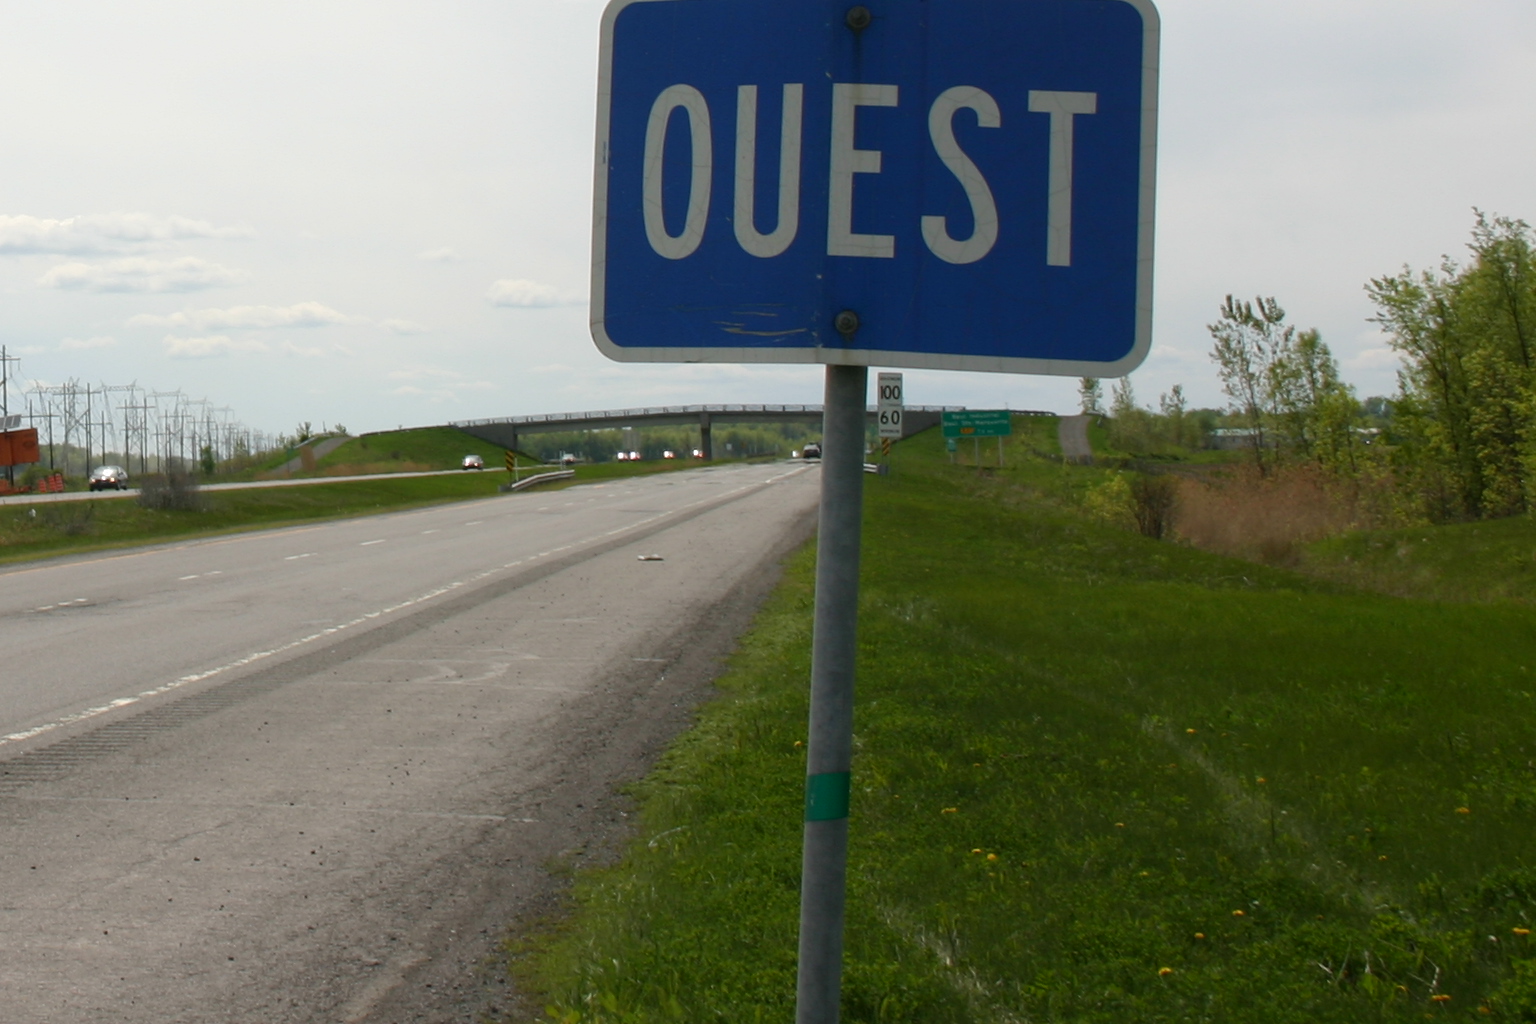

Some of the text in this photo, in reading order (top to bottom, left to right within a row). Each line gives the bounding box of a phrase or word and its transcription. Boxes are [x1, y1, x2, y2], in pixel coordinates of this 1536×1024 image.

[642, 82, 1098, 267] OUEST
[880, 385, 901, 400] 100
[880, 410, 900, 425] 60
